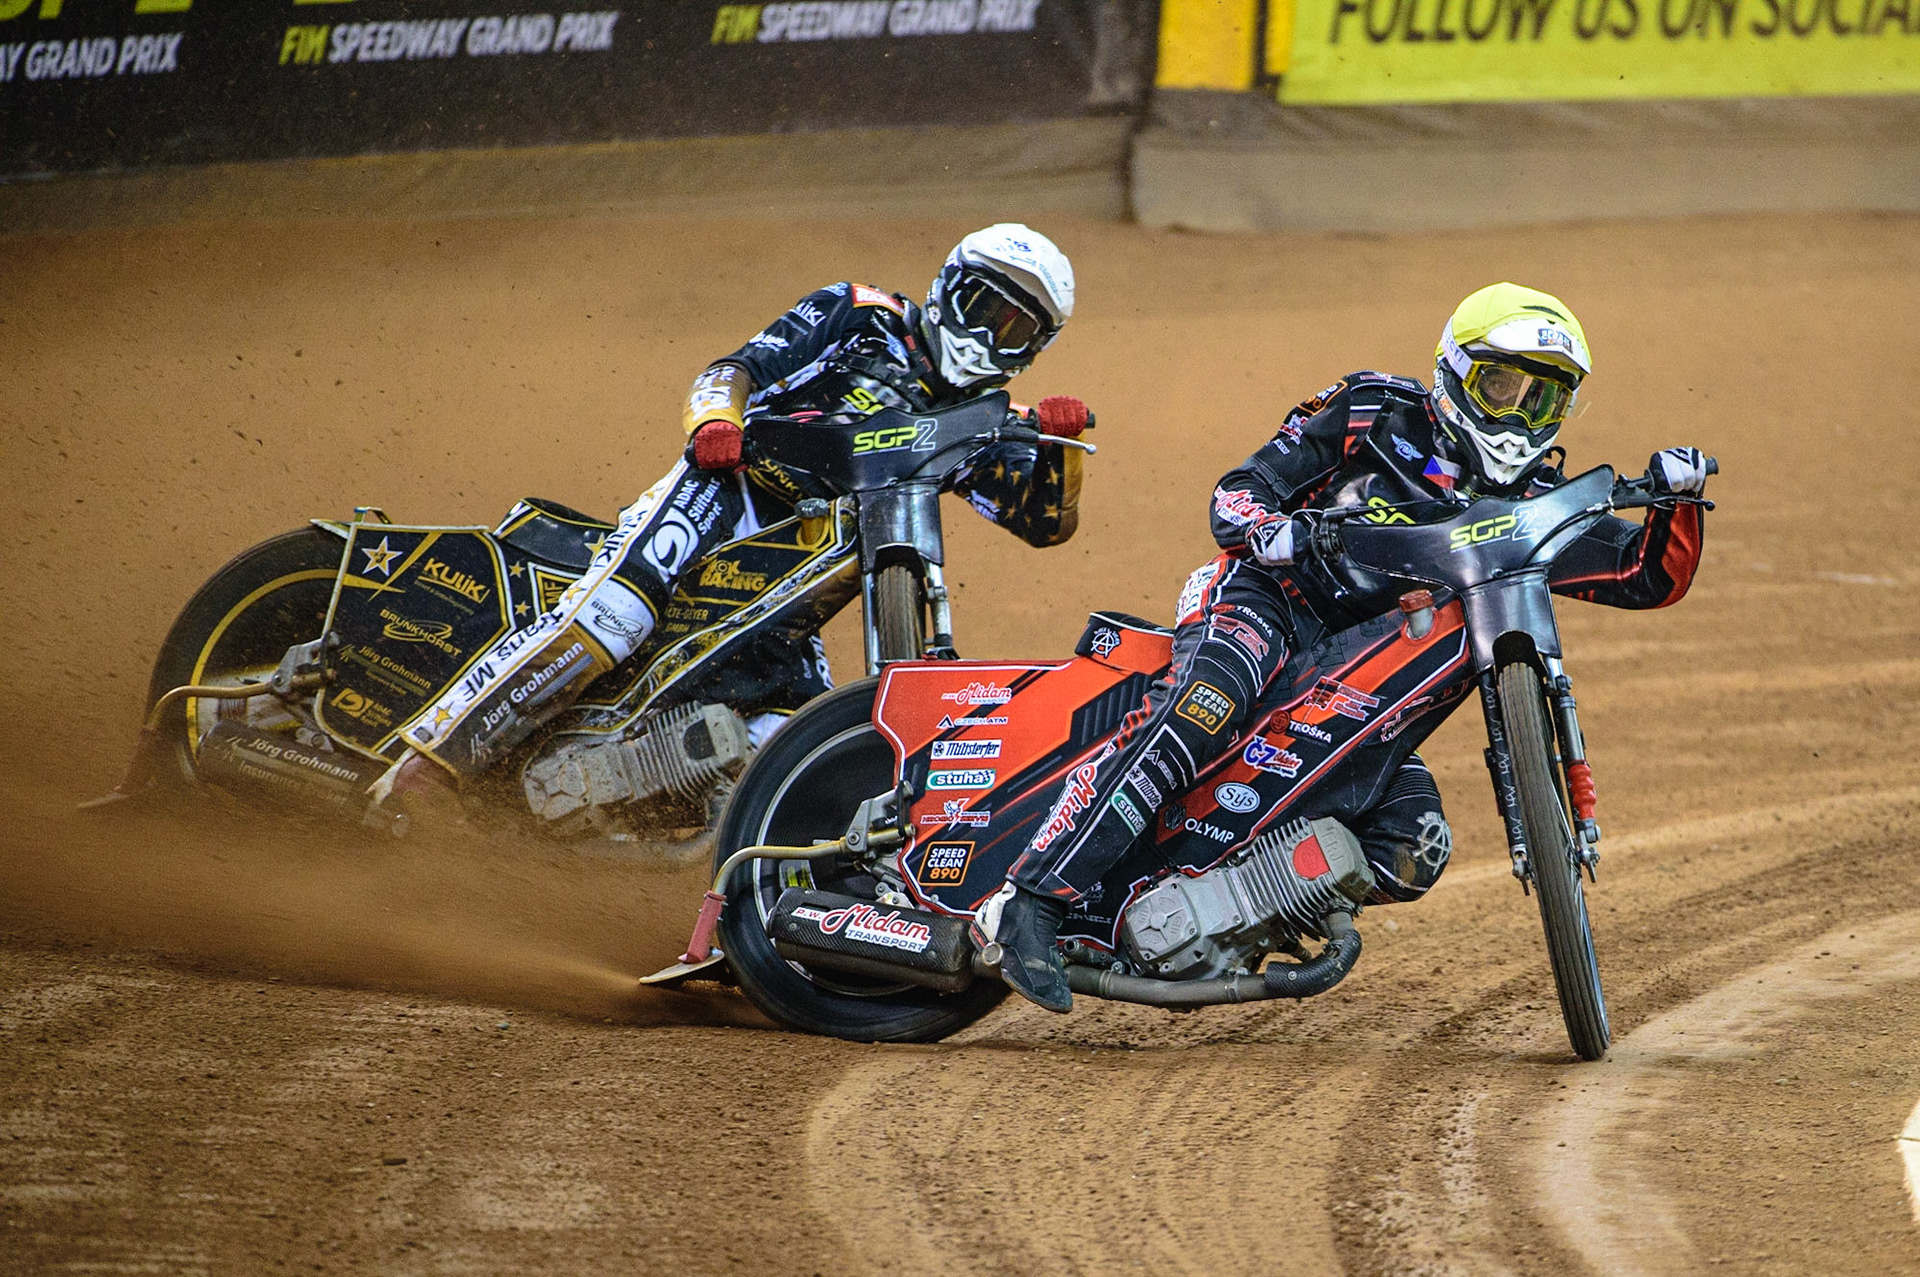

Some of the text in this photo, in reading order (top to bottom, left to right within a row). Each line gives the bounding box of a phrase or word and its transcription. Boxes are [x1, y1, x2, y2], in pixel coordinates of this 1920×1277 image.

[887, 0, 978, 37] GRAND
[278, 10, 620, 65] FIM SPEEDWAY GRAND PRIX
[25, 37, 118, 81] GRAND
[117, 31, 184, 75] PRIX
[673, 479, 700, 509] ADAC
[697, 501, 724, 535] Sport
[700, 572, 766, 592] RACING
[380, 608, 463, 657] BRUNKHORST
[359, 646, 381, 663] Jörg
[381, 656, 432, 690] Grohmann
[462, 661, 496, 703] MF
[482, 641, 585, 732] Jörg Grohmann
[956, 683, 1011, 704] Midam
[1195, 685, 1230, 710] SPEED
[1187, 703, 1217, 726] 890
[1191, 693, 1226, 718] CLEAN
[1289, 720, 1333, 744] TROŠKA
[248, 737, 359, 782] Jörg Grohmann
[936, 772, 984, 785] stuha
[1036, 763, 1097, 850] Midam
[1184, 817, 1235, 844] OLYMP
[927, 858, 964, 868] CLEAN
[930, 847, 967, 858] SPEED
[929, 867, 961, 880] 890
[820, 903, 930, 941] Midam
[847, 928, 926, 952] TRANSPORT
